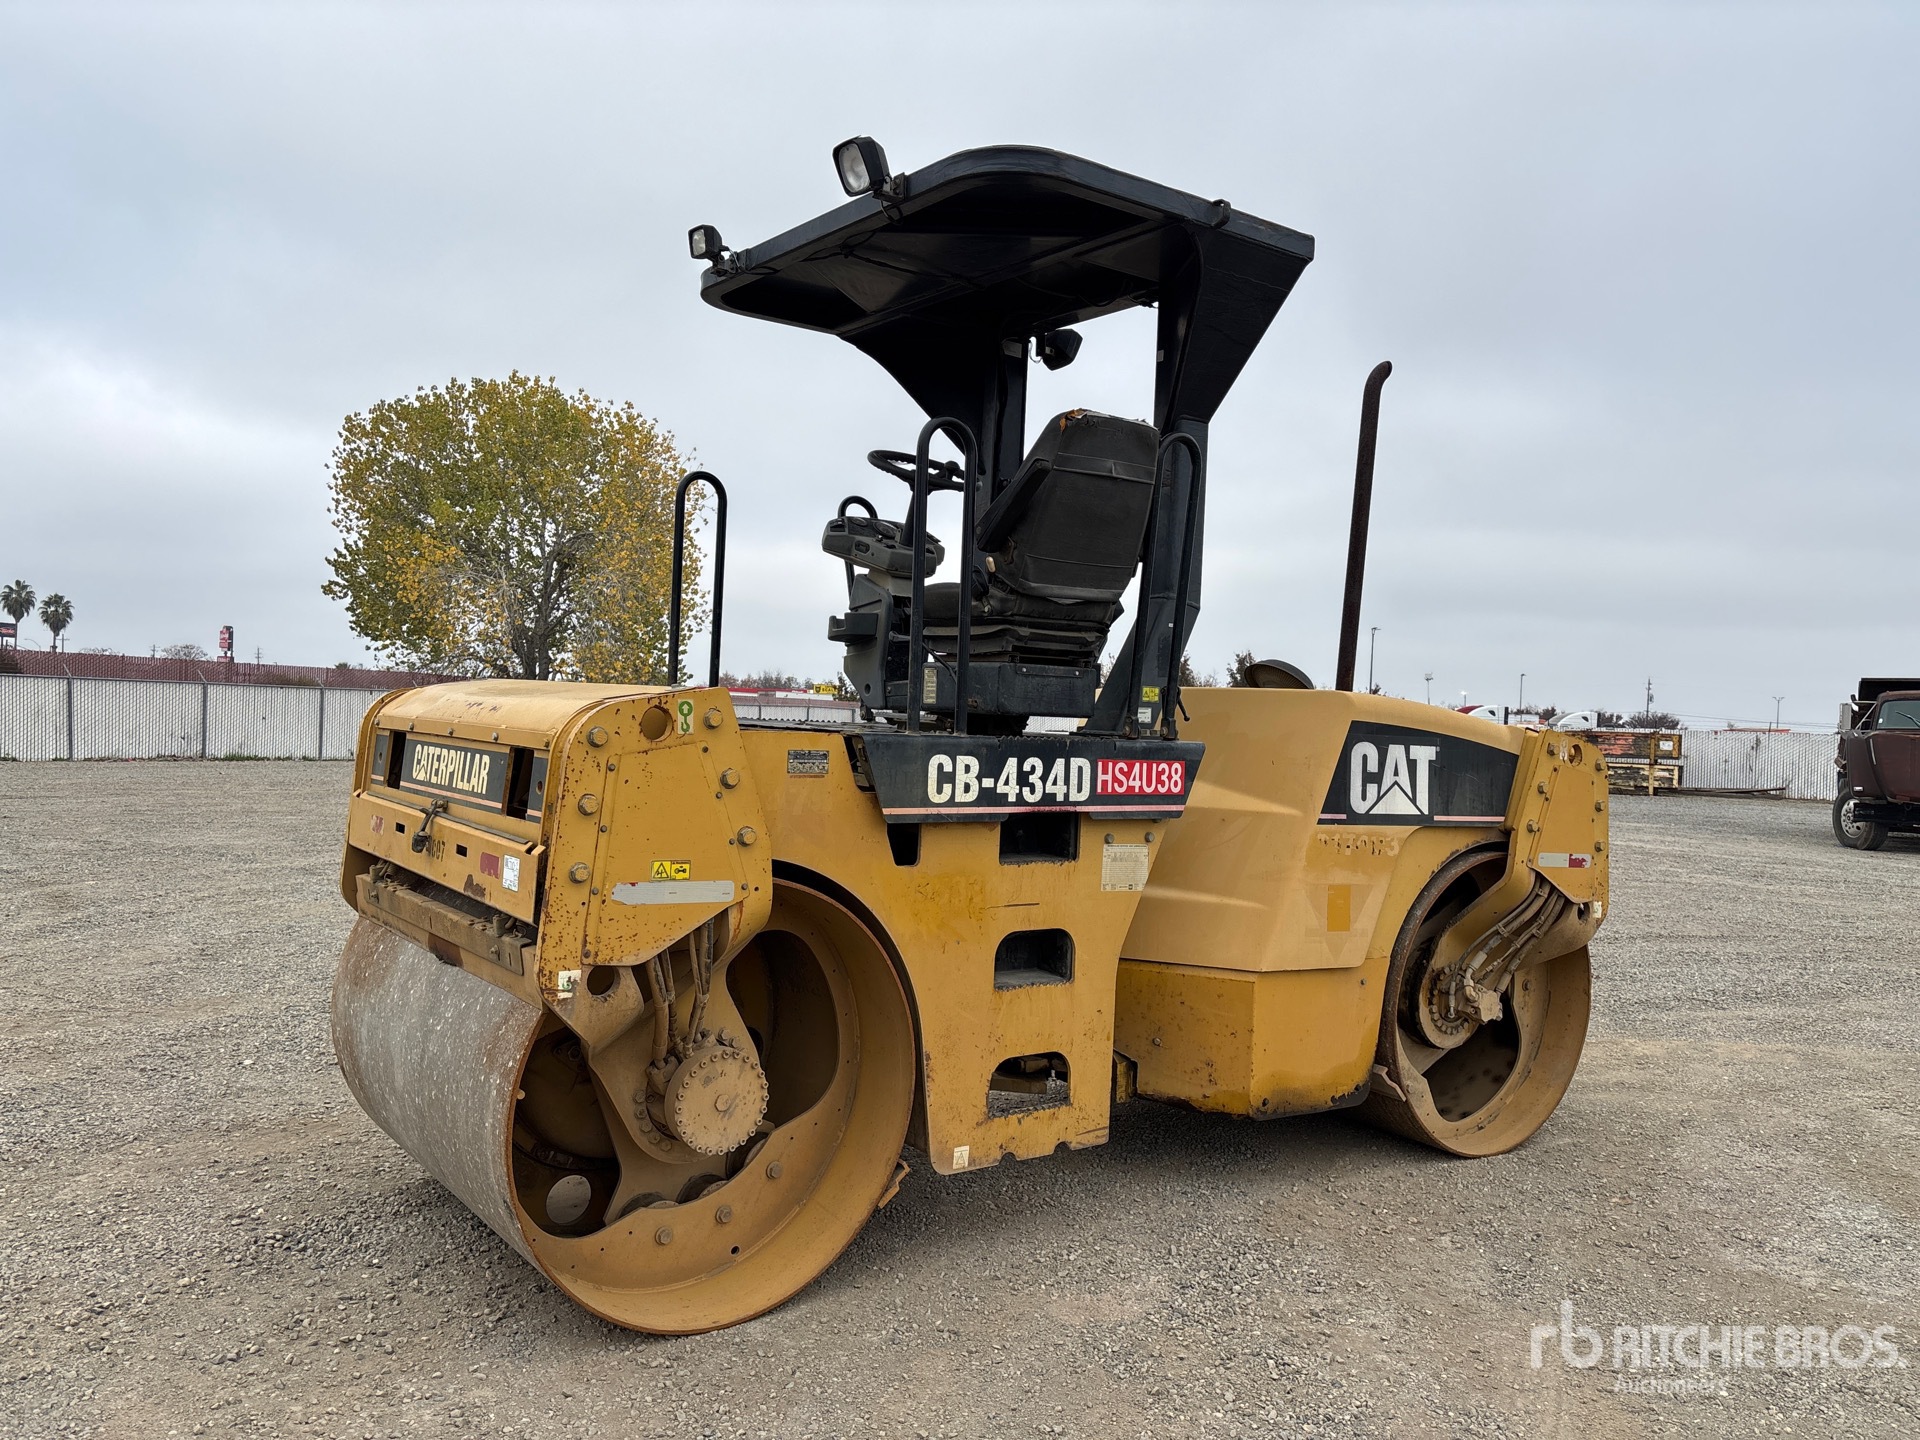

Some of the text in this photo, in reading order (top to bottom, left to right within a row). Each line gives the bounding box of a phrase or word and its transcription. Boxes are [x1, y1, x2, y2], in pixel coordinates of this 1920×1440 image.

[412, 743, 490, 795] CATERPILLAR
[927, 753, 1091, 803] CB-434D
[1097, 761, 1182, 793] HS4U38
[1350, 741, 1437, 815] CAT
